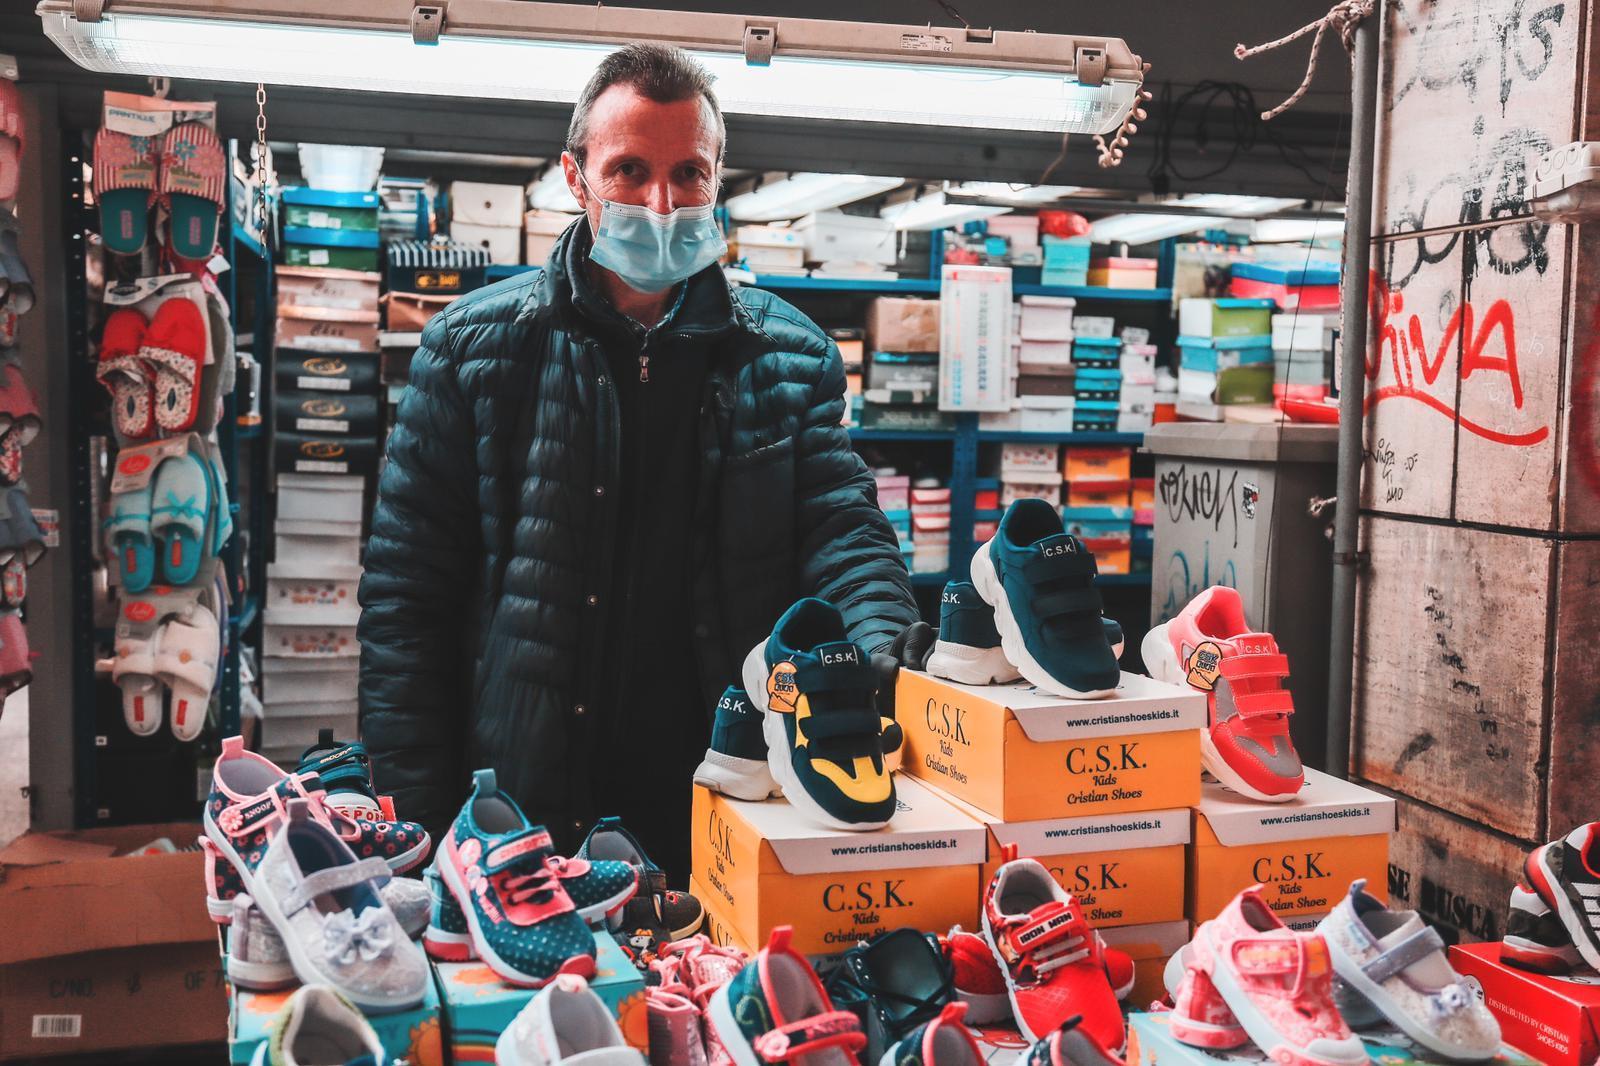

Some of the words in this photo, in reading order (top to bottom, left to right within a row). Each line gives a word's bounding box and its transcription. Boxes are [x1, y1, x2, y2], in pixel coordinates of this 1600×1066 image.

[925, 697, 971, 747] C.S.K.
[1066, 709, 1179, 728] www.cristianshoeskids.it
[939, 739, 953, 758] Kids
[1065, 742, 1147, 776] C.S.K.
[925, 755, 949, 777] Cristian
[949, 766, 968, 785] Shoes
[1092, 774, 1118, 787] Kids
[1067, 790, 1108, 806] Cristian
[1111, 787, 1142, 801] Shoes
[1260, 807, 1370, 826] www.cristianshoeskids.it
[709, 809, 735, 868] C.S.K.
[1045, 819, 1161, 839] www.cristianshoeskids.it
[831, 838, 957, 857] www.cristianshoeskids.it
[1252, 852, 1331, 884] C.S.K.
[822, 879, 914, 913] C.S.K.
[1278, 882, 1303, 895] Kids
[1296, 896, 1327, 909] Shoes
[852, 910, 880, 925] Kids
[1090, 907, 1123, 920] Shoes
[823, 927, 871, 944] Cristian
[1019, 925, 1046, 945] IRON
[1048, 912, 1073, 929] MAN
[1530, 1017, 1540, 1029] BY
[1539, 1022, 1569, 1044] CRISTIAN
[1536, 1032, 1555, 1048] SHOES
